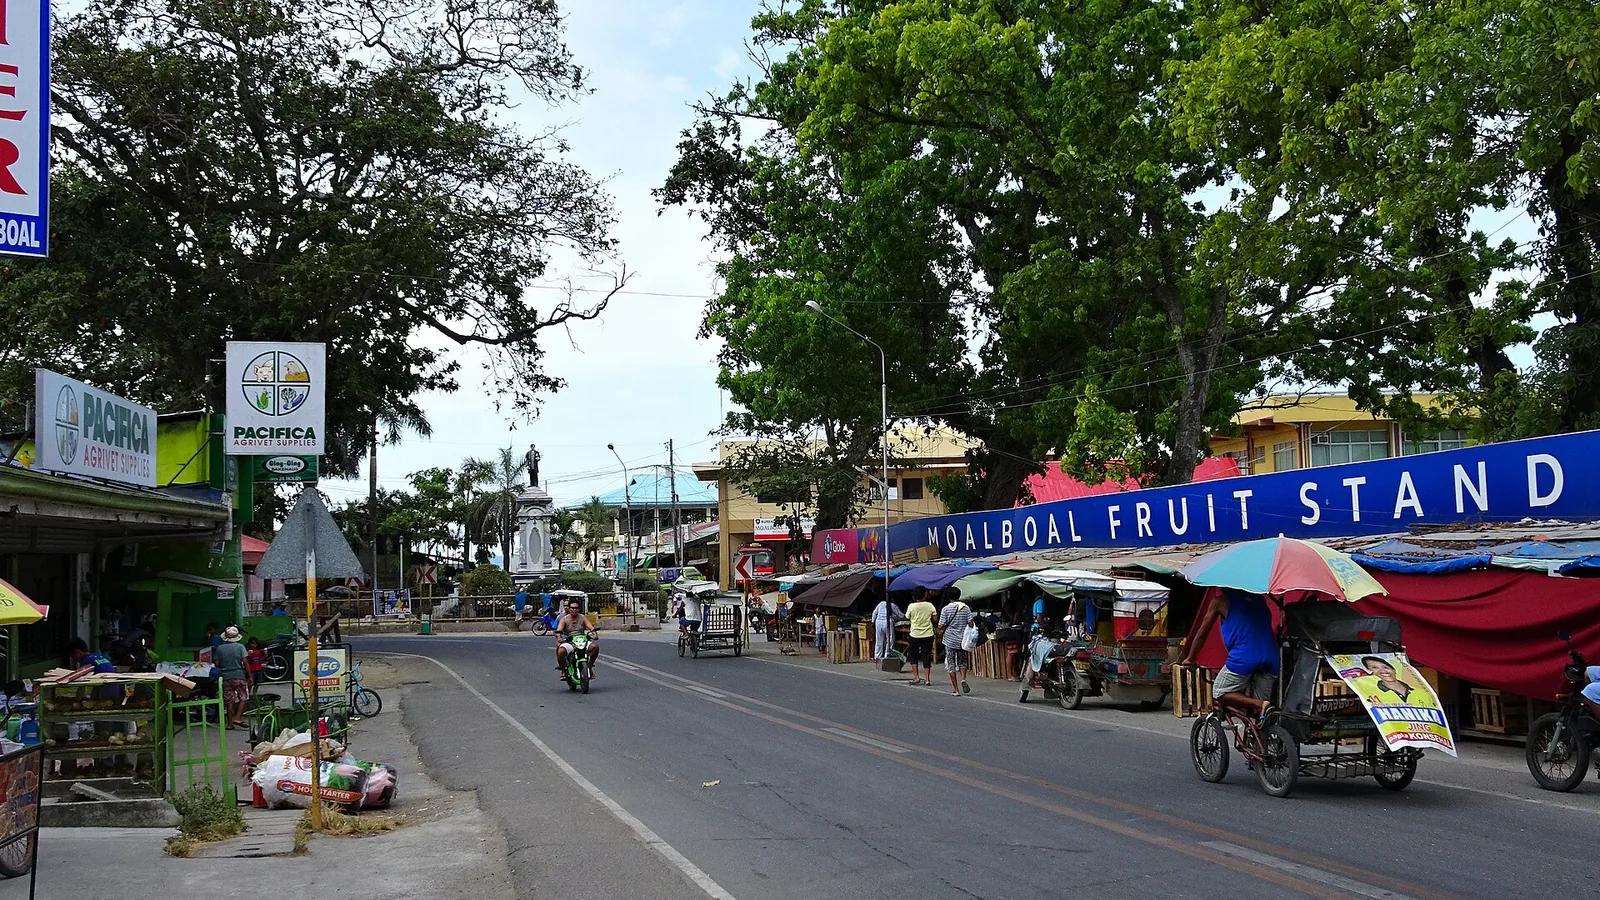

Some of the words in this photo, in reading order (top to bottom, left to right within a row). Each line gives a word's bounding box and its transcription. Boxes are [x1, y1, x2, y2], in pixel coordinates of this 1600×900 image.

[84, 392, 149, 455] PACIFICA
[234, 426, 316, 439] PACIFICA
[84, 445, 119, 472] AGRIVET
[121, 453, 150, 478] SUPPLIES
[269, 460, 301, 468] Ging-Ging
[928, 510, 1081, 552] MOALBOAL
[1107, 490, 1253, 539] FRUIT
[1299, 453, 1564, 526] STAND
[833, 541, 846, 553] Globe
[302, 679, 338, 687] PMIUM
[1408, 723, 1432, 731] JING
[297, 785, 314, 795] HO
